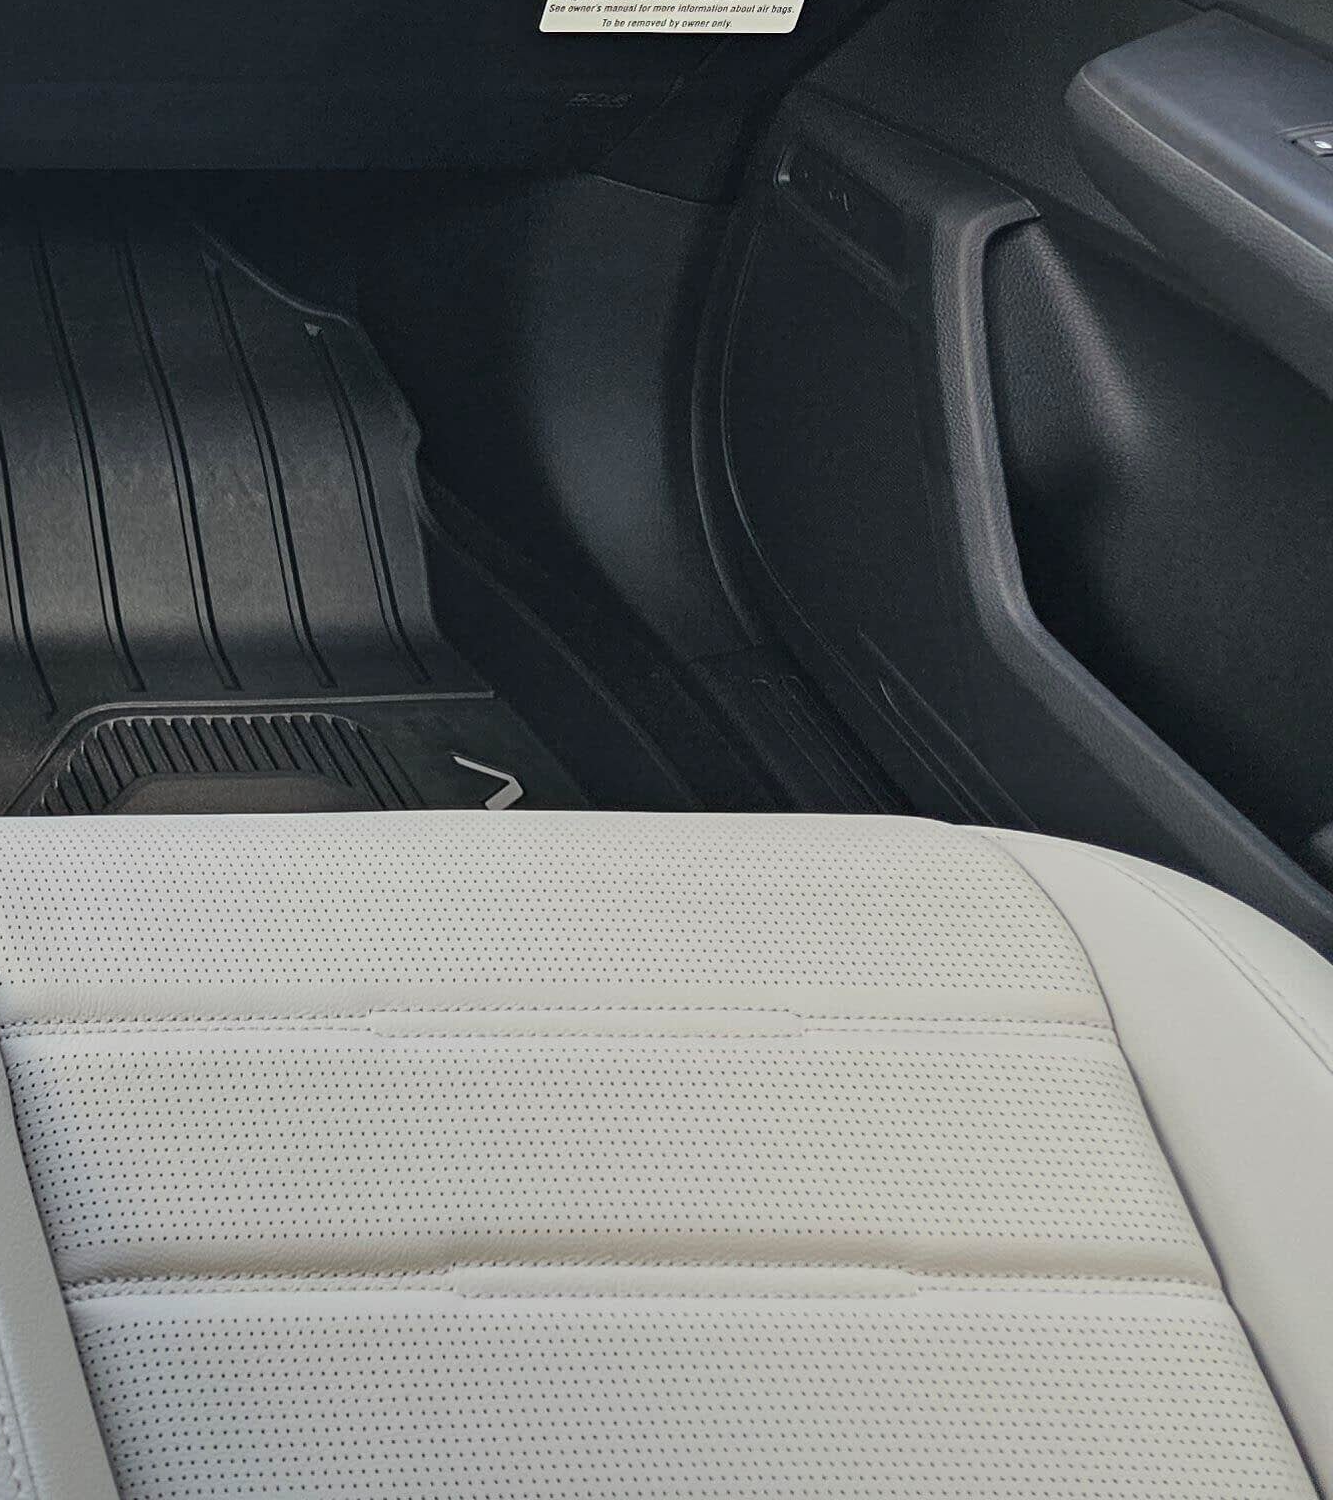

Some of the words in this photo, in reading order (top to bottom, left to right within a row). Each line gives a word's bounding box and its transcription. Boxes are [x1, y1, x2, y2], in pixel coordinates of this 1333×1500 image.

[549, 4, 566, 13] See
[568, 4, 602, 13] owner's
[604, 4, 638, 13] manual
[638, 4, 651, 13] for
[652, 5, 676, 13] more
[677, 4, 729, 13] information
[729, 4, 756, 13] about
[757, 4, 770, 13] air
[601, 18, 612, 28] To
[614, 18, 626, 27] be
[627, 18, 667, 28] removed
[668, 18, 680, 29] by
[681, 20, 712, 28] owner
